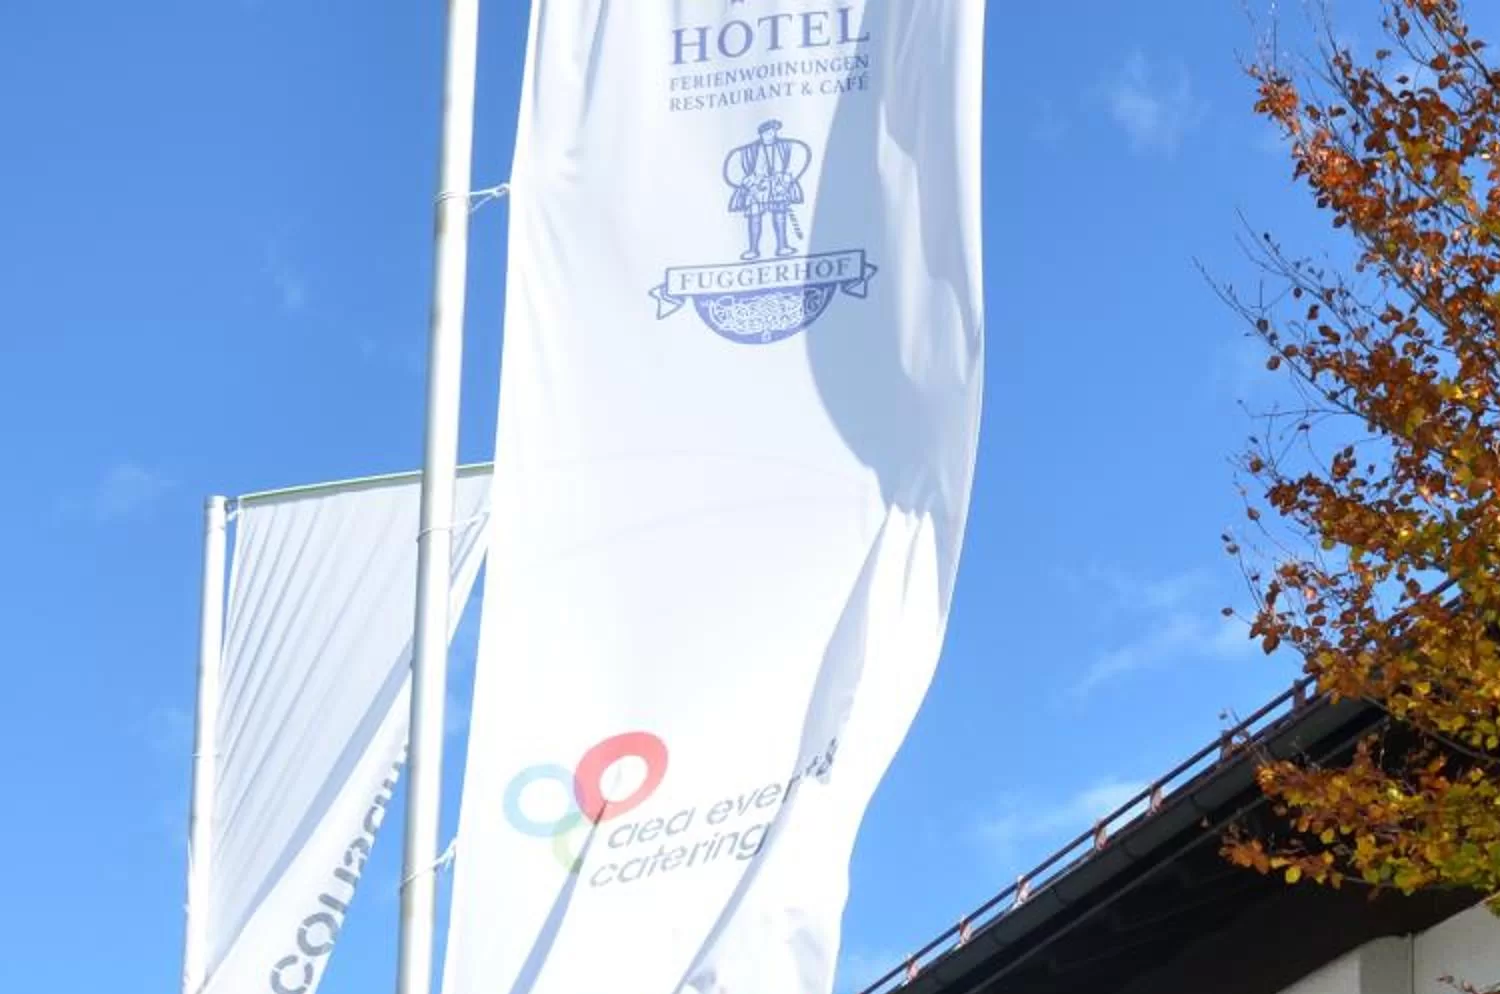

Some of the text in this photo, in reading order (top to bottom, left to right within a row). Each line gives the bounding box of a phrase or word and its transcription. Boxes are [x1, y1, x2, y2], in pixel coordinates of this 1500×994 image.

[670, 6, 870, 66] HOTEL
[669, 53, 869, 92] FERIENWOHNUNGEN
[669, 81, 794, 112] RESTAURANT
[800, 80, 813, 97] &
[680, 258, 850, 291] FUGGERHOF
[589, 820, 773, 888] catering
